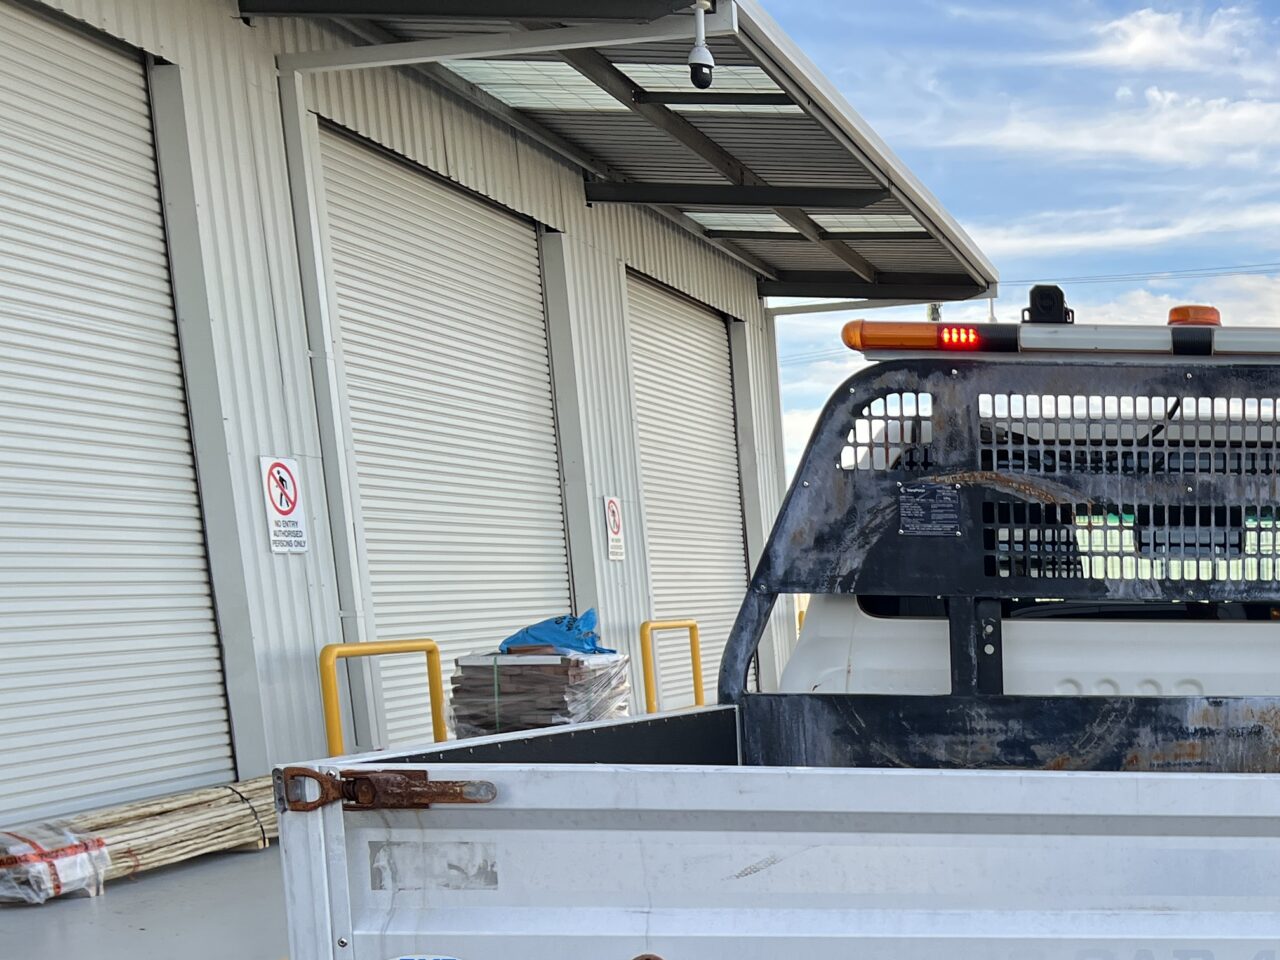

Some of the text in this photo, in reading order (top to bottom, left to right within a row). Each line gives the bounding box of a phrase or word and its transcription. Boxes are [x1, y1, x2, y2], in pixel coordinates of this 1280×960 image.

[282, 520, 298, 528] ENTRY
[273, 530, 303, 538] AUTHORISED
[272, 539, 306, 548] PERSONS ONLY
